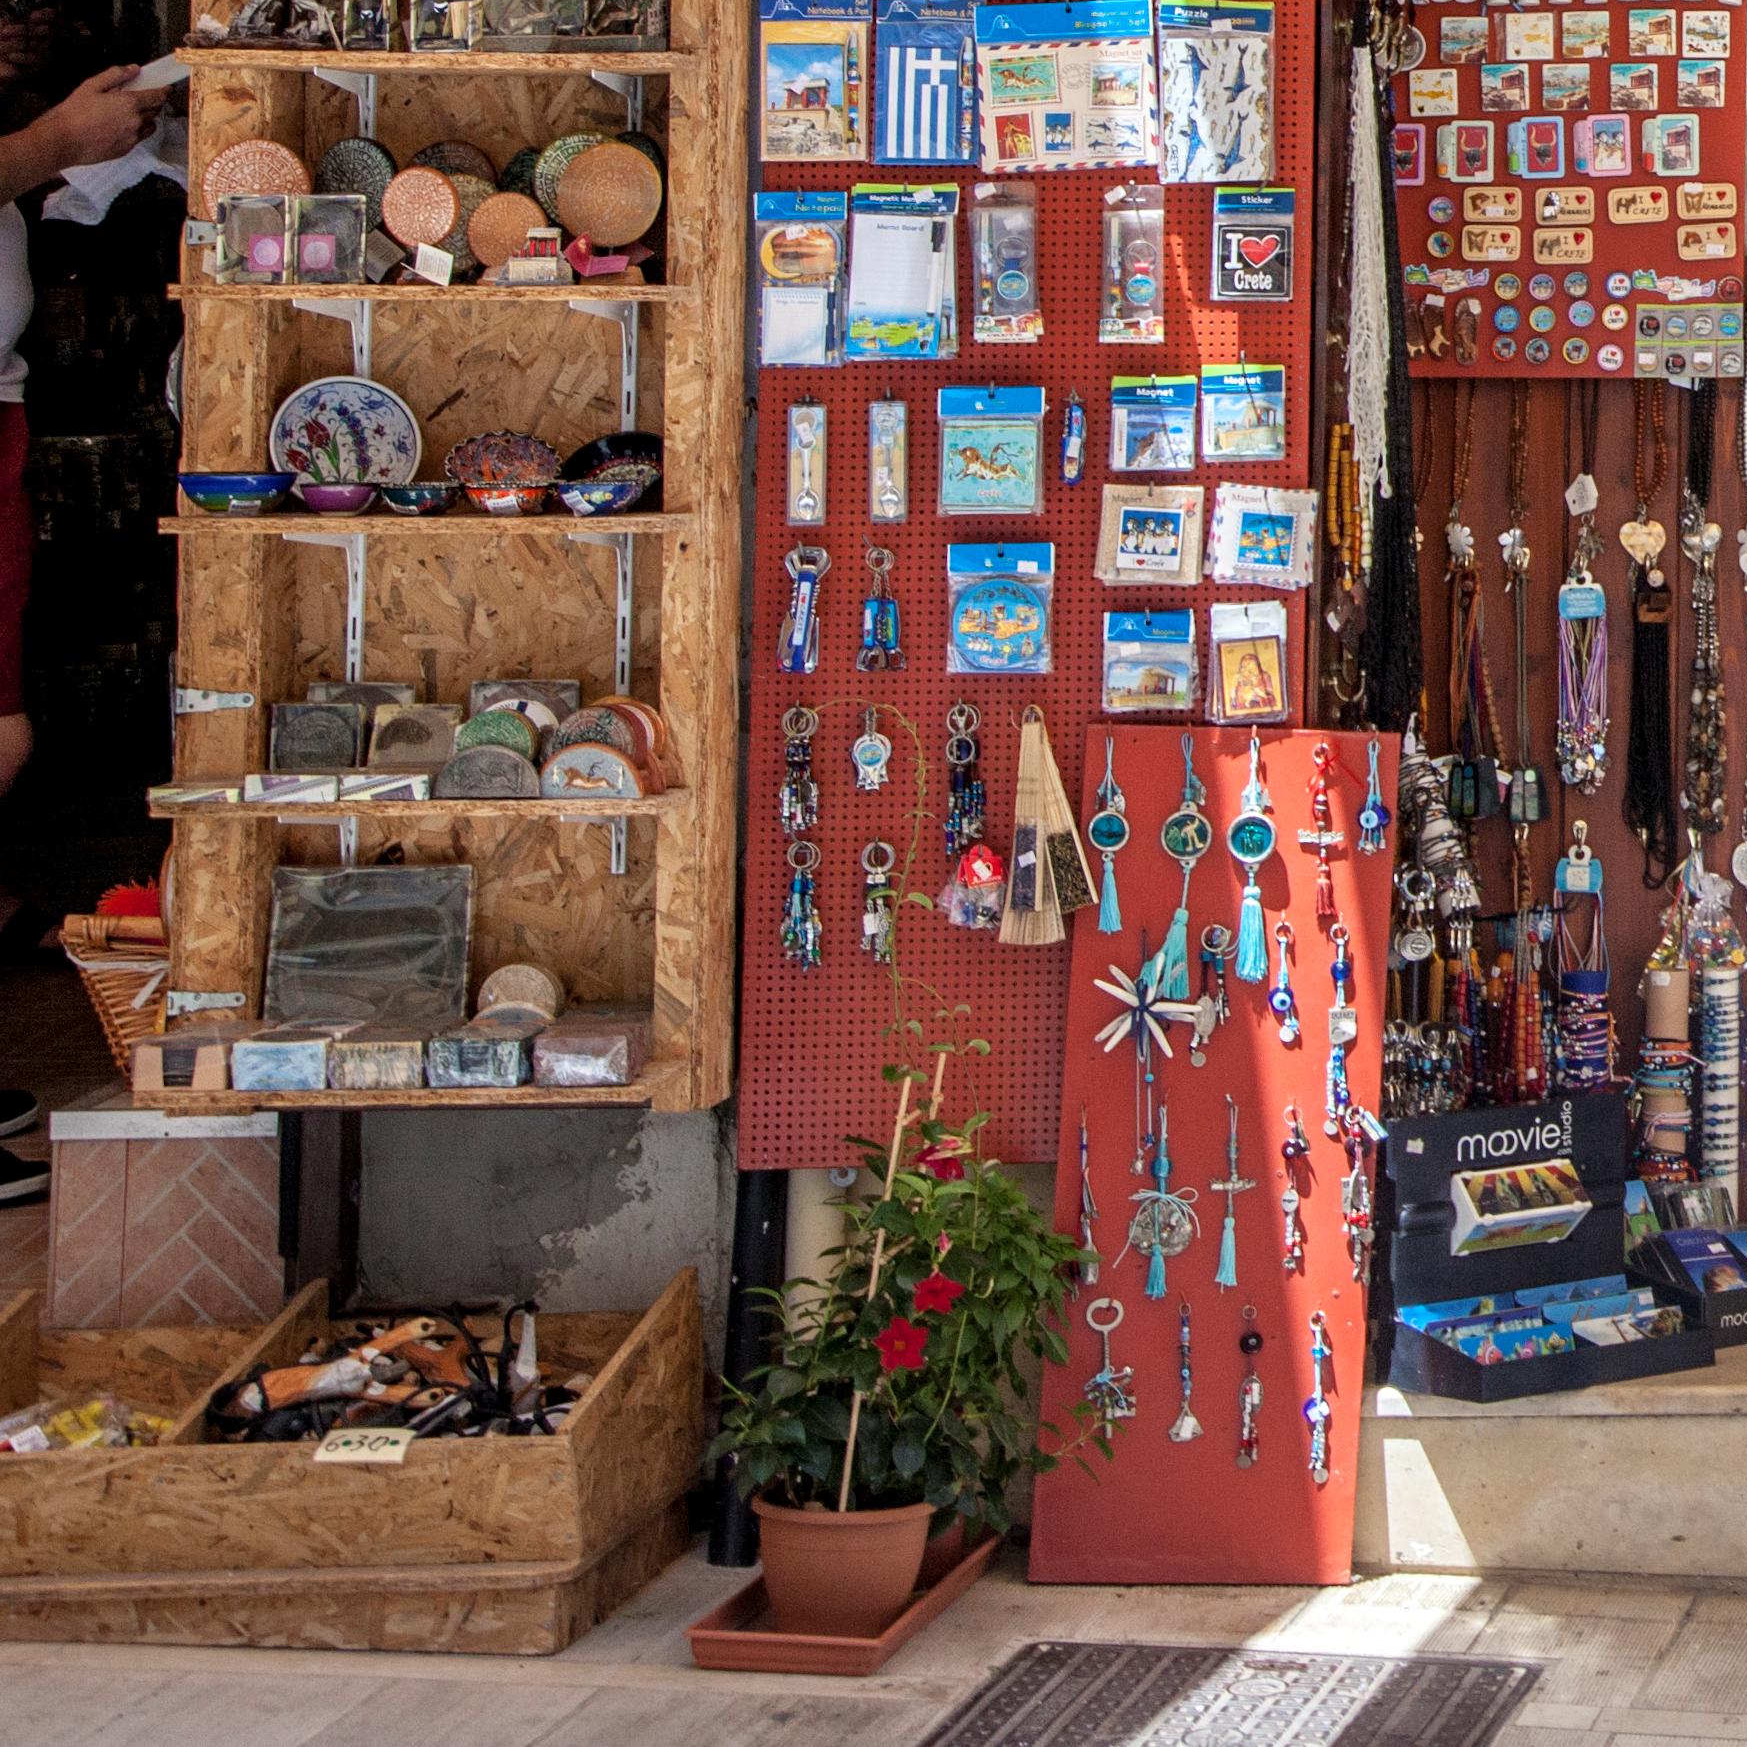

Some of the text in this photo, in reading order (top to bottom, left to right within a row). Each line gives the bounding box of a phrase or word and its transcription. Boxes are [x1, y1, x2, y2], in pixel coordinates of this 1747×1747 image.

[1174, 7, 1208, 19] Puzzle
[1171, 144, 1179, 175] CRETE
[1241, 195, 1273, 206] Sticker
[1633, 206, 1662, 215] CRETE
[1225, 233, 1244, 270] I
[1556, 249, 1586, 258] CRETE
[1234, 271, 1272, 290] Crete
[1602, 356, 1618, 364] CRETE
[1224, 376, 1261, 386] Magnet
[1136, 387, 1174, 398] Magnet
[1560, 1101, 1572, 1147] studio
[1457, 1117, 1561, 1162] moovie
